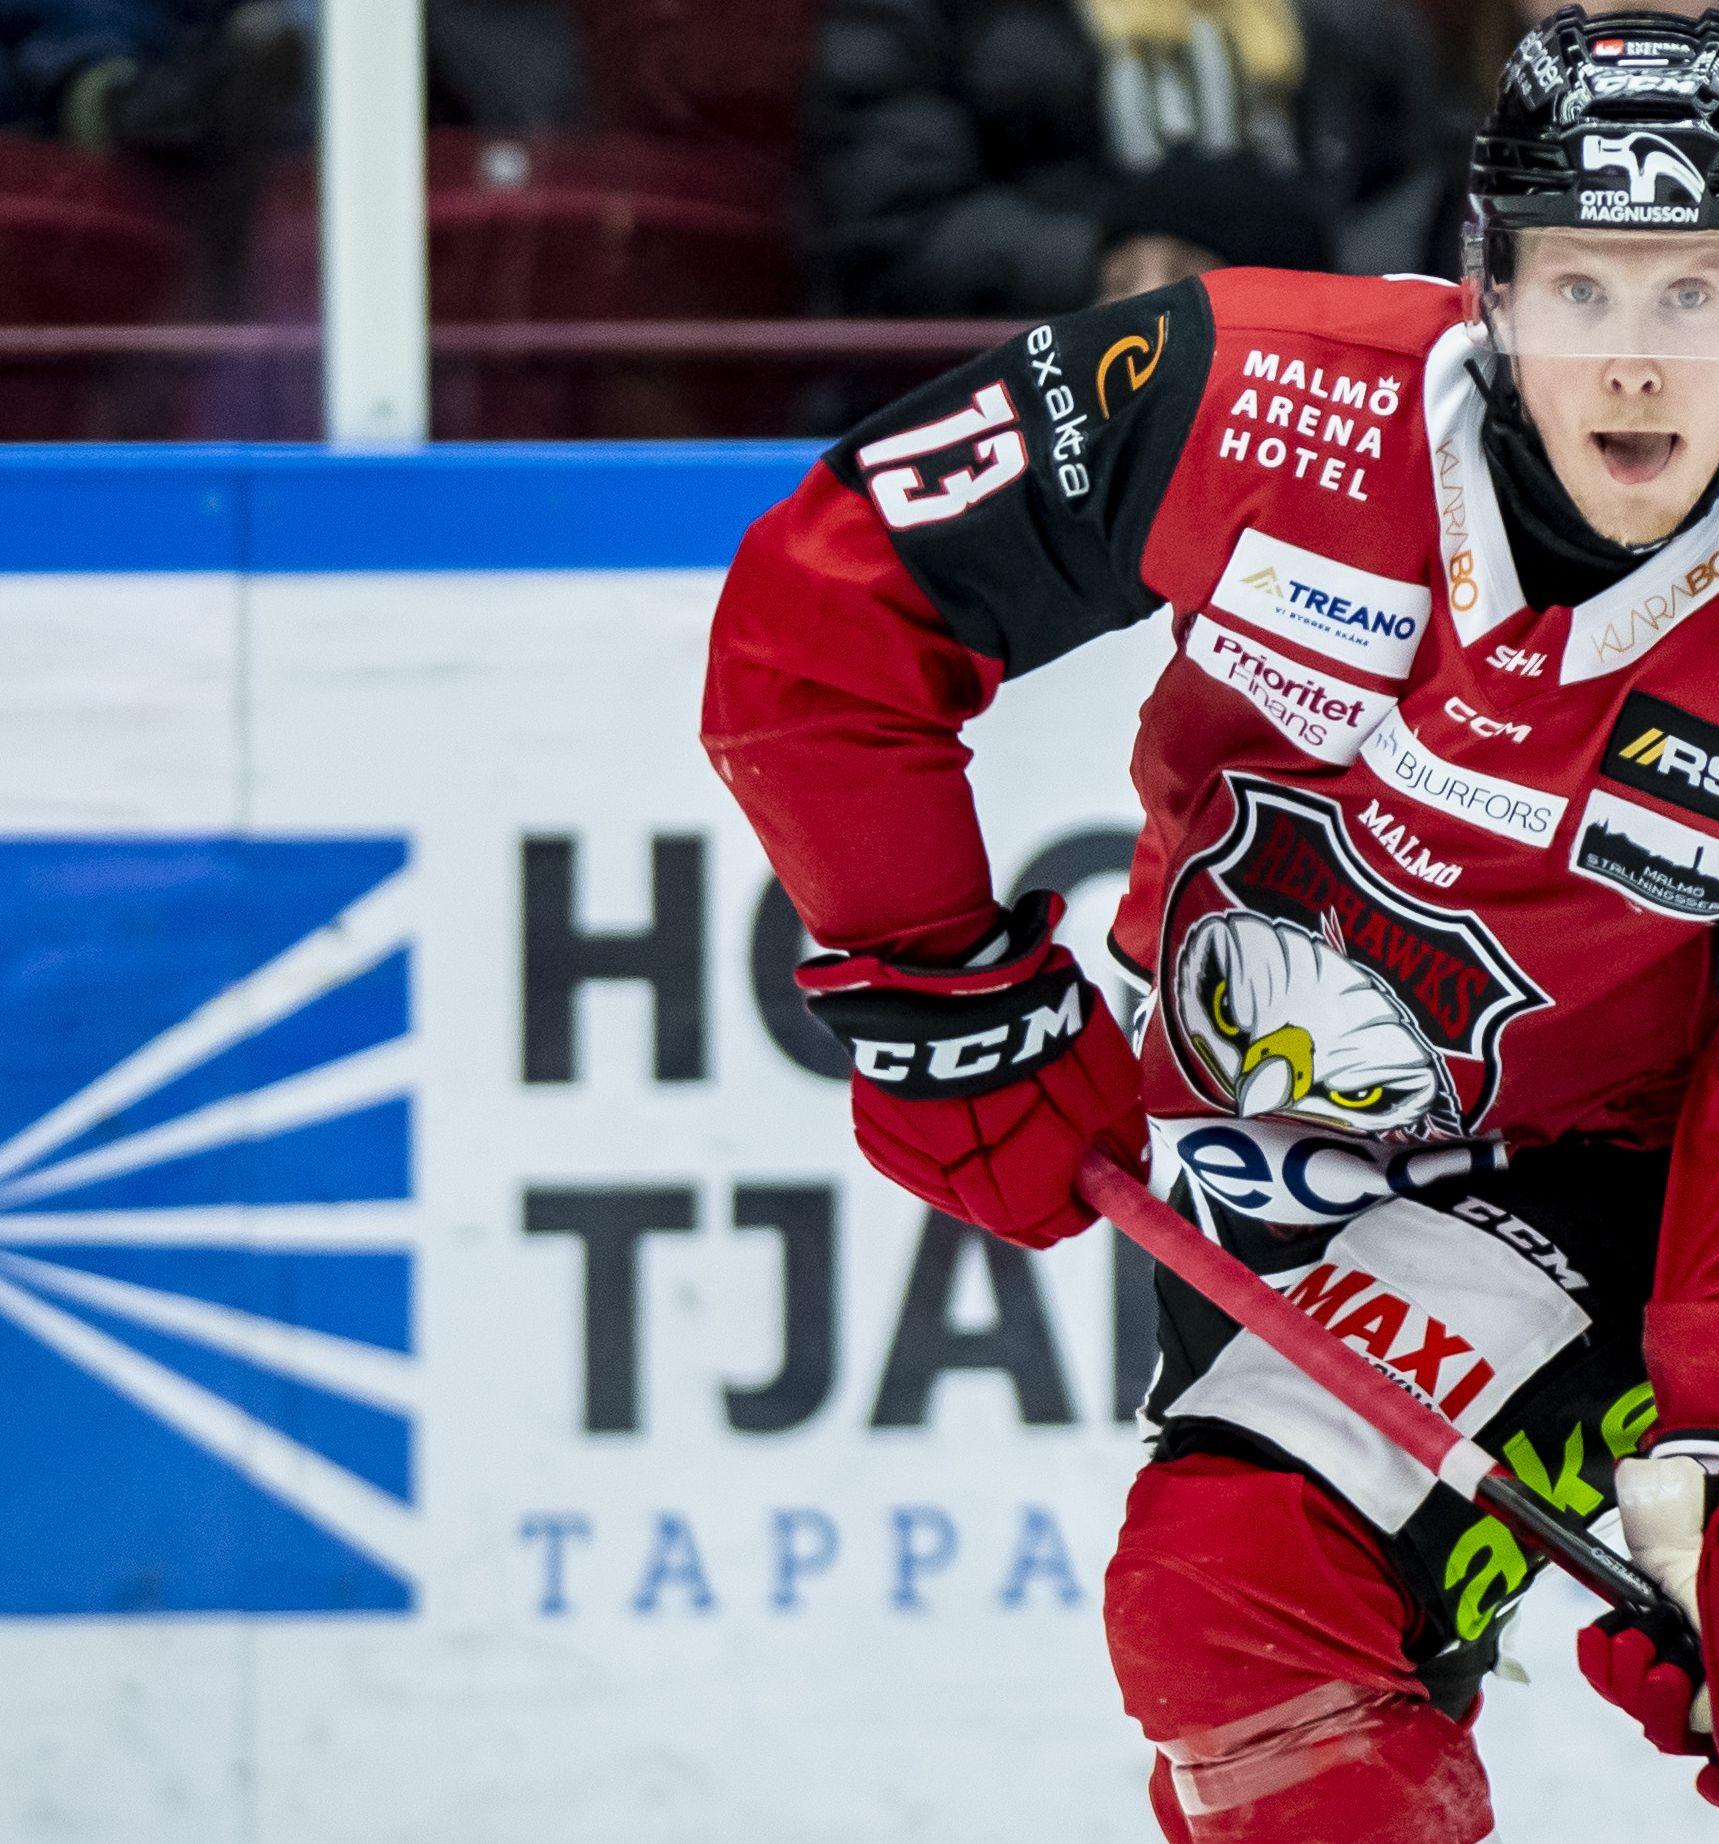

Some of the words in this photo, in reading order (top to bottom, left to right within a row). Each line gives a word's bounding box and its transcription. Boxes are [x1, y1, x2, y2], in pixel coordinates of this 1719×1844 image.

[1580, 190, 1629, 207] OTTO
[1580, 205, 1699, 223] MAGNUSSON
[1026, 323, 1090, 498] exakta
[1231, 389, 1382, 459] ARENA
[857, 379, 1029, 532] 13
[1219, 429, 1369, 502] HOTEL
[1289, 580, 1416, 640] TREANO
[1213, 634, 1365, 728] Prioritet
[1228, 661, 1327, 746] Finans
[1486, 644, 1549, 679] SHL
[1443, 696, 1532, 744] CCM
[1395, 749, 1552, 833] BJURFORS
[1243, 814, 1490, 1040] REDHAWKS
[851, 984, 1085, 1082] CCM
[1452, 1195, 1590, 1290] CCM
[1285, 1262, 1496, 1423] MAXI
[518, 1503, 1085, 1618] TAPPA
